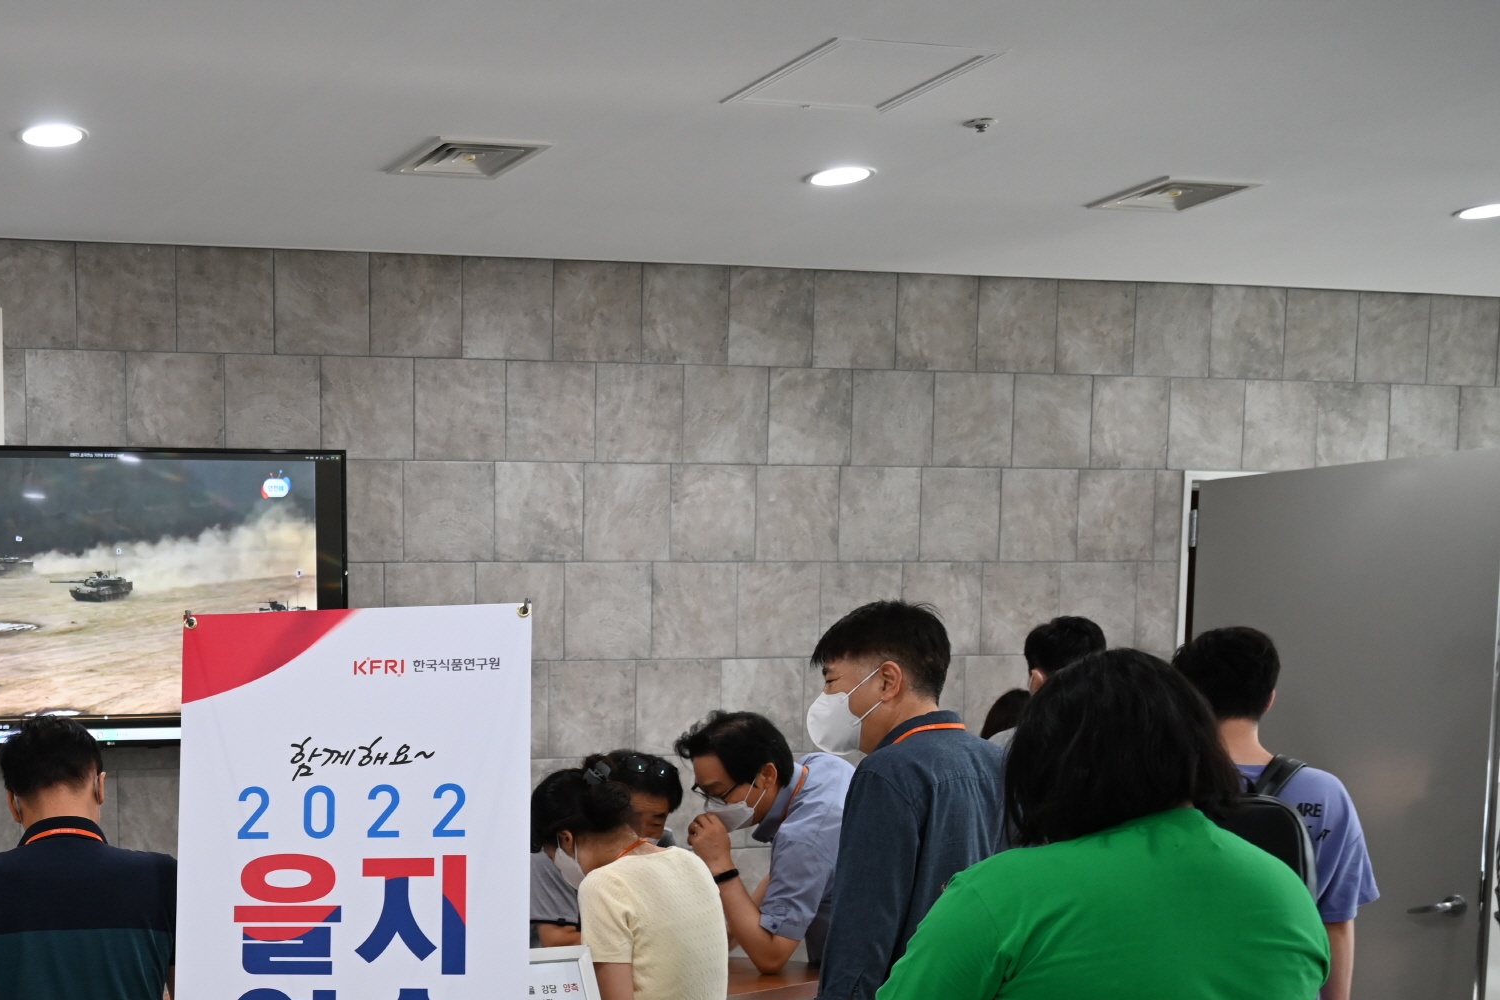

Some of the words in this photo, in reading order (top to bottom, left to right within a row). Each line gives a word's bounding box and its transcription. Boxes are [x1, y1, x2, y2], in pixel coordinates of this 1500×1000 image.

[353, 658, 405, 677] KFRI
[412, 657, 501, 673] 한국식품연구원
[237, 783, 466, 840] 2022
[233, 853, 467, 976] 을지
[541, 984, 557, 995] 강당
